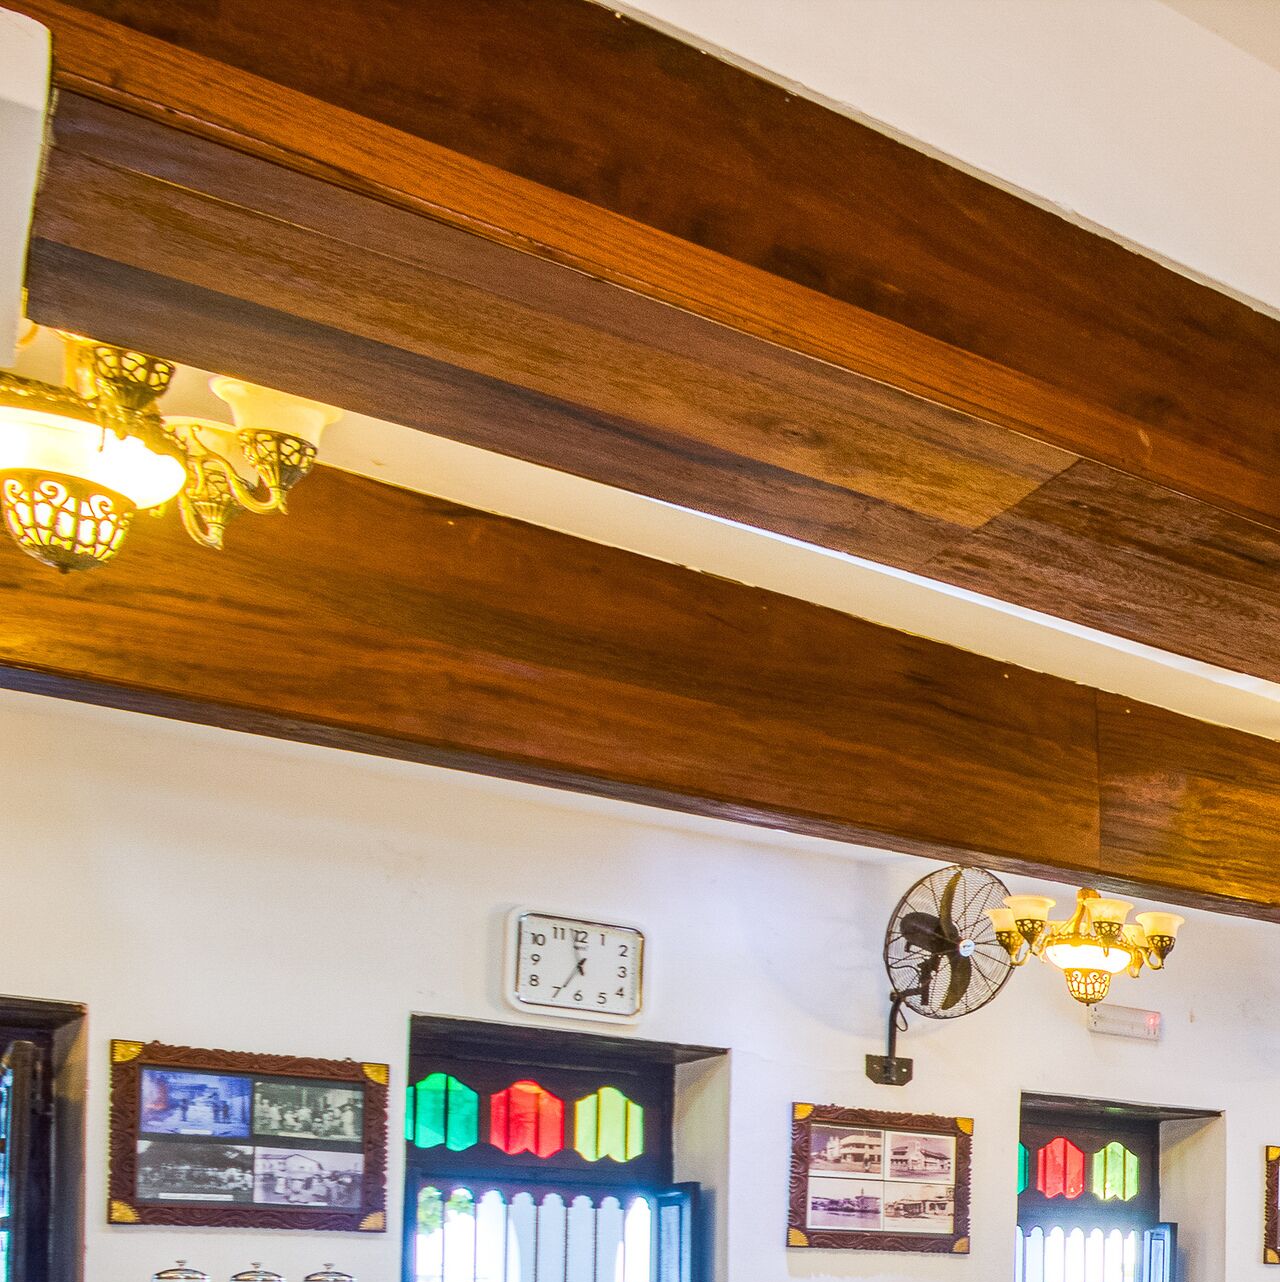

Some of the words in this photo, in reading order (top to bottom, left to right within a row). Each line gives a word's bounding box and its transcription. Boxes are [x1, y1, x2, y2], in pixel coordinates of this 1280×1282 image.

[530, 932, 546, 946] 10
[552, 926, 565, 940] 11
[569, 928, 588, 943] 12
[619, 944, 628, 957] 2
[530, 953, 541, 965] 9
[618, 966, 627, 979] 3
[529, 974, 539, 987] 8
[552, 985, 562, 998] 7
[573, 990, 583, 1001] 6
[596, 992, 607, 1004] 5
[614, 987, 625, 997] 4
